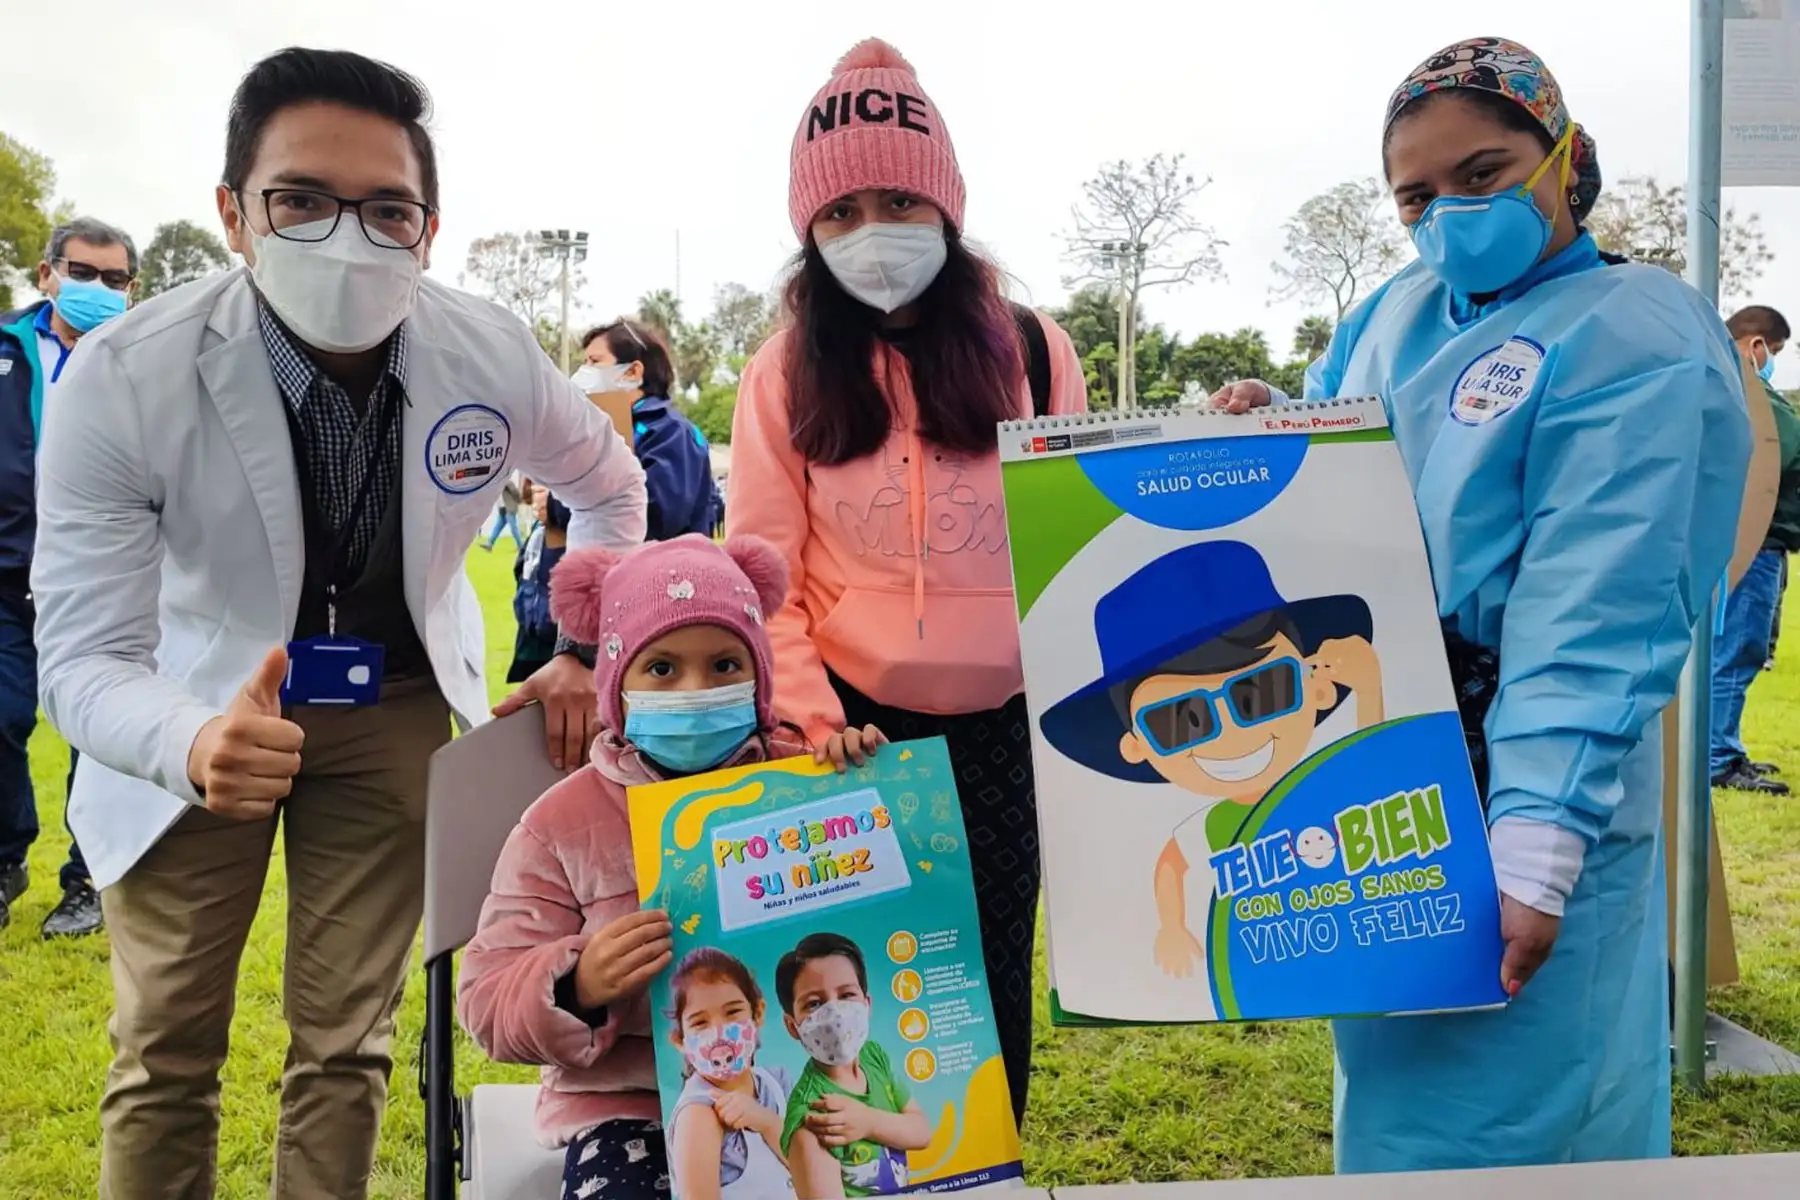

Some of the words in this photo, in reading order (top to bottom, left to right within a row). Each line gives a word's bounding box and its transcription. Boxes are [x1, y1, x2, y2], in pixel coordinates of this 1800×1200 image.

[808, 88, 930, 142] NICE
[1491, 381, 1523, 399] SUR
[435, 450, 471, 467] LIMA
[475, 447, 503, 461] SUR
[448, 430, 494, 450] DIRIS
[1137, 475, 1191, 496] SALUD
[1197, 467, 1271, 489] OCULAR
[713, 805, 891, 868] Protejamos
[1208, 842, 1252, 900] TE
[1250, 829, 1299, 888] VE
[1333, 783, 1451, 876] BIEN
[745, 871, 785, 900] su
[791, 848, 874, 889] niñez
[763, 898, 787, 910] Niñas
[788, 898, 794, 907] y
[794, 891, 817, 904] niños
[818, 880, 861, 897] saludables
[1235, 891, 1284, 921] CON
[1289, 880, 1354, 913] OJOS
[1361, 865, 1446, 900] SANOS
[1240, 913, 1338, 964] VIVO
[1351, 893, 1465, 946] FELIZ
